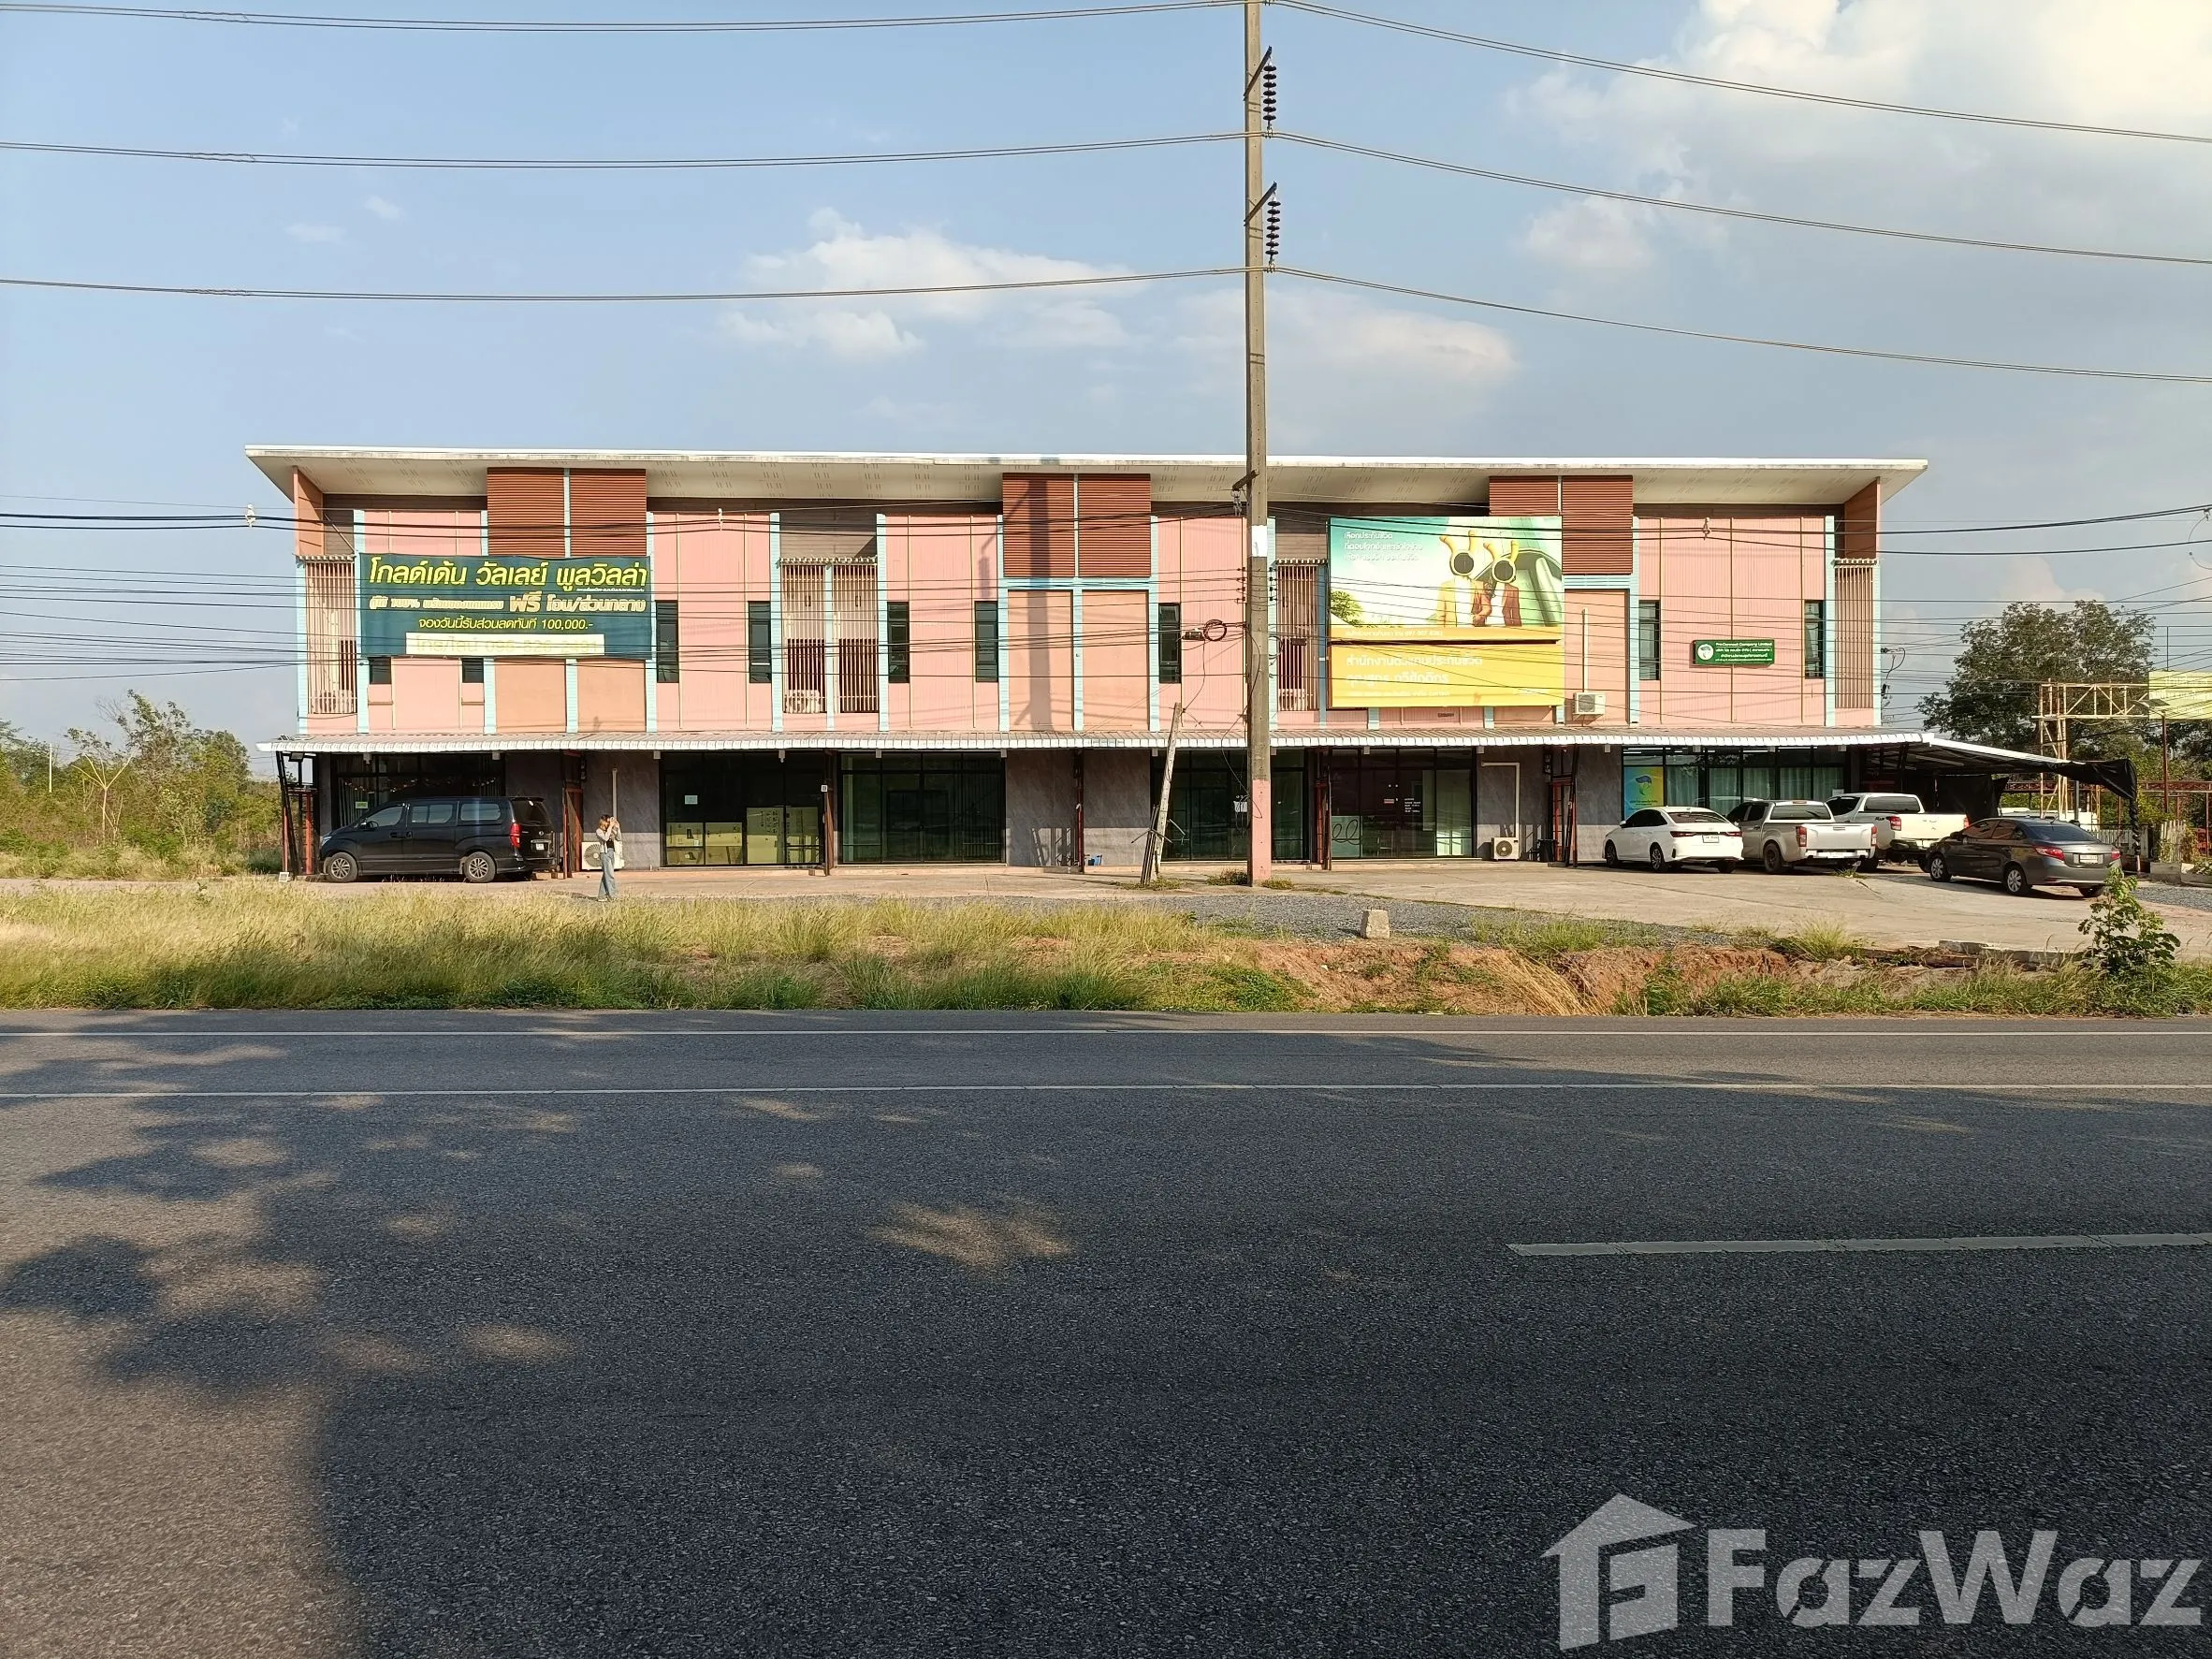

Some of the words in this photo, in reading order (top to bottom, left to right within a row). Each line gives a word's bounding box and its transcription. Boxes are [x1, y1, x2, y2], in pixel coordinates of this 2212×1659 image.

[369, 556, 468, 586] โกลด์เด้น
[475, 560, 549, 586] วัลเลย์
[556, 561, 648, 592] พูลวิลล่า
[509, 590, 543, 613] ฟรี
[546, 592, 647, 613] โอน/ส่วนกลาง
[418, 614, 538, 631] จองวันนี้รับส่วนลดทันที
[541, 618, 594, 631] 100,000.-
